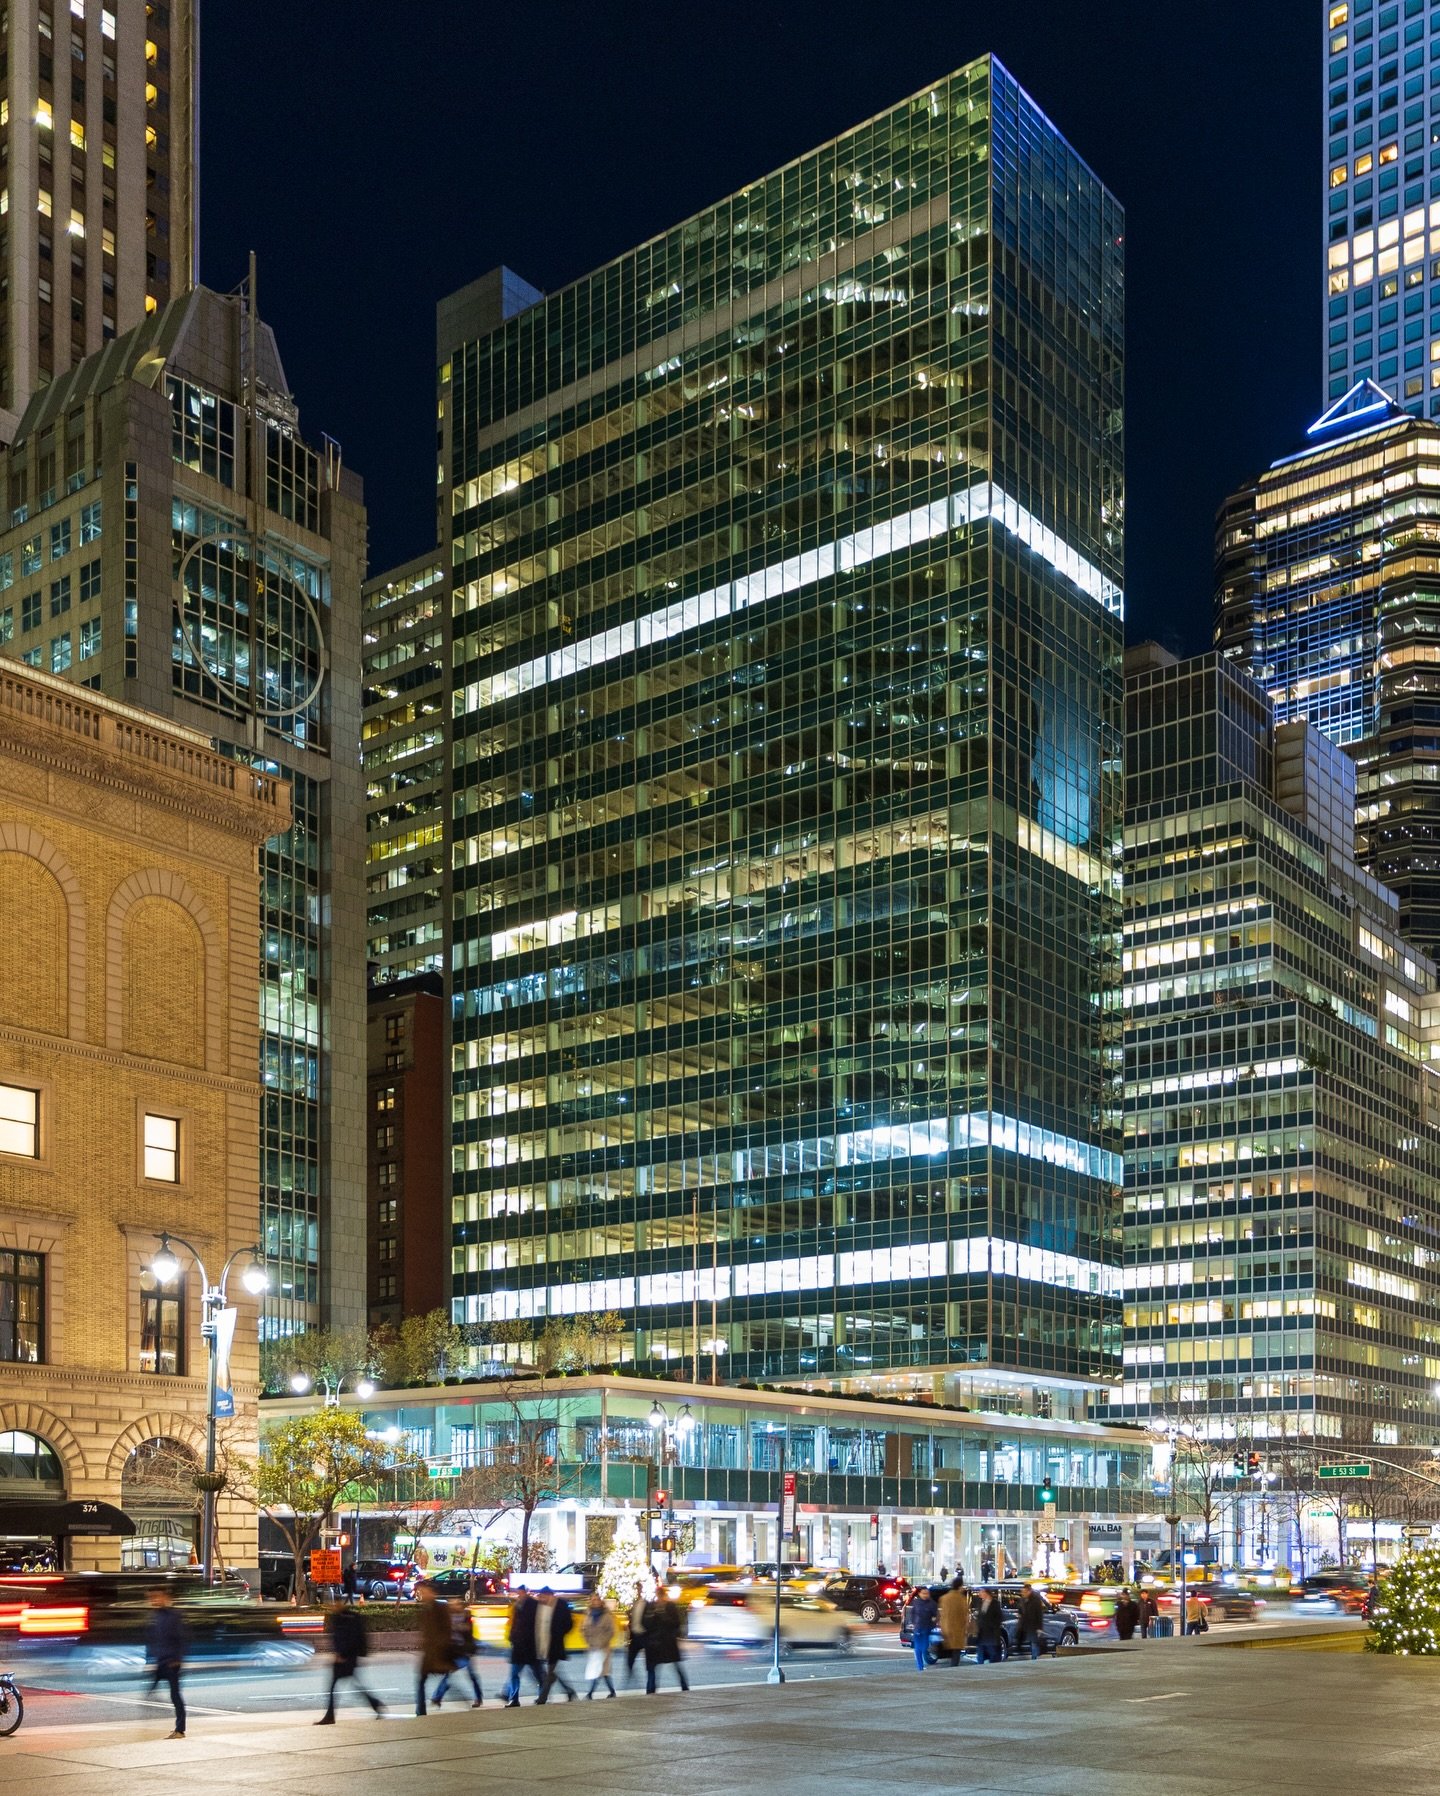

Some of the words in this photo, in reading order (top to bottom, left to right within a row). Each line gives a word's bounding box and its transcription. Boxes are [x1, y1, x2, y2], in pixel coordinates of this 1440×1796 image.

[1339, 1467, 1347, 1475] 53
[1348, 1467, 1356, 1475] St
[82, 1504, 98, 1513] 374
